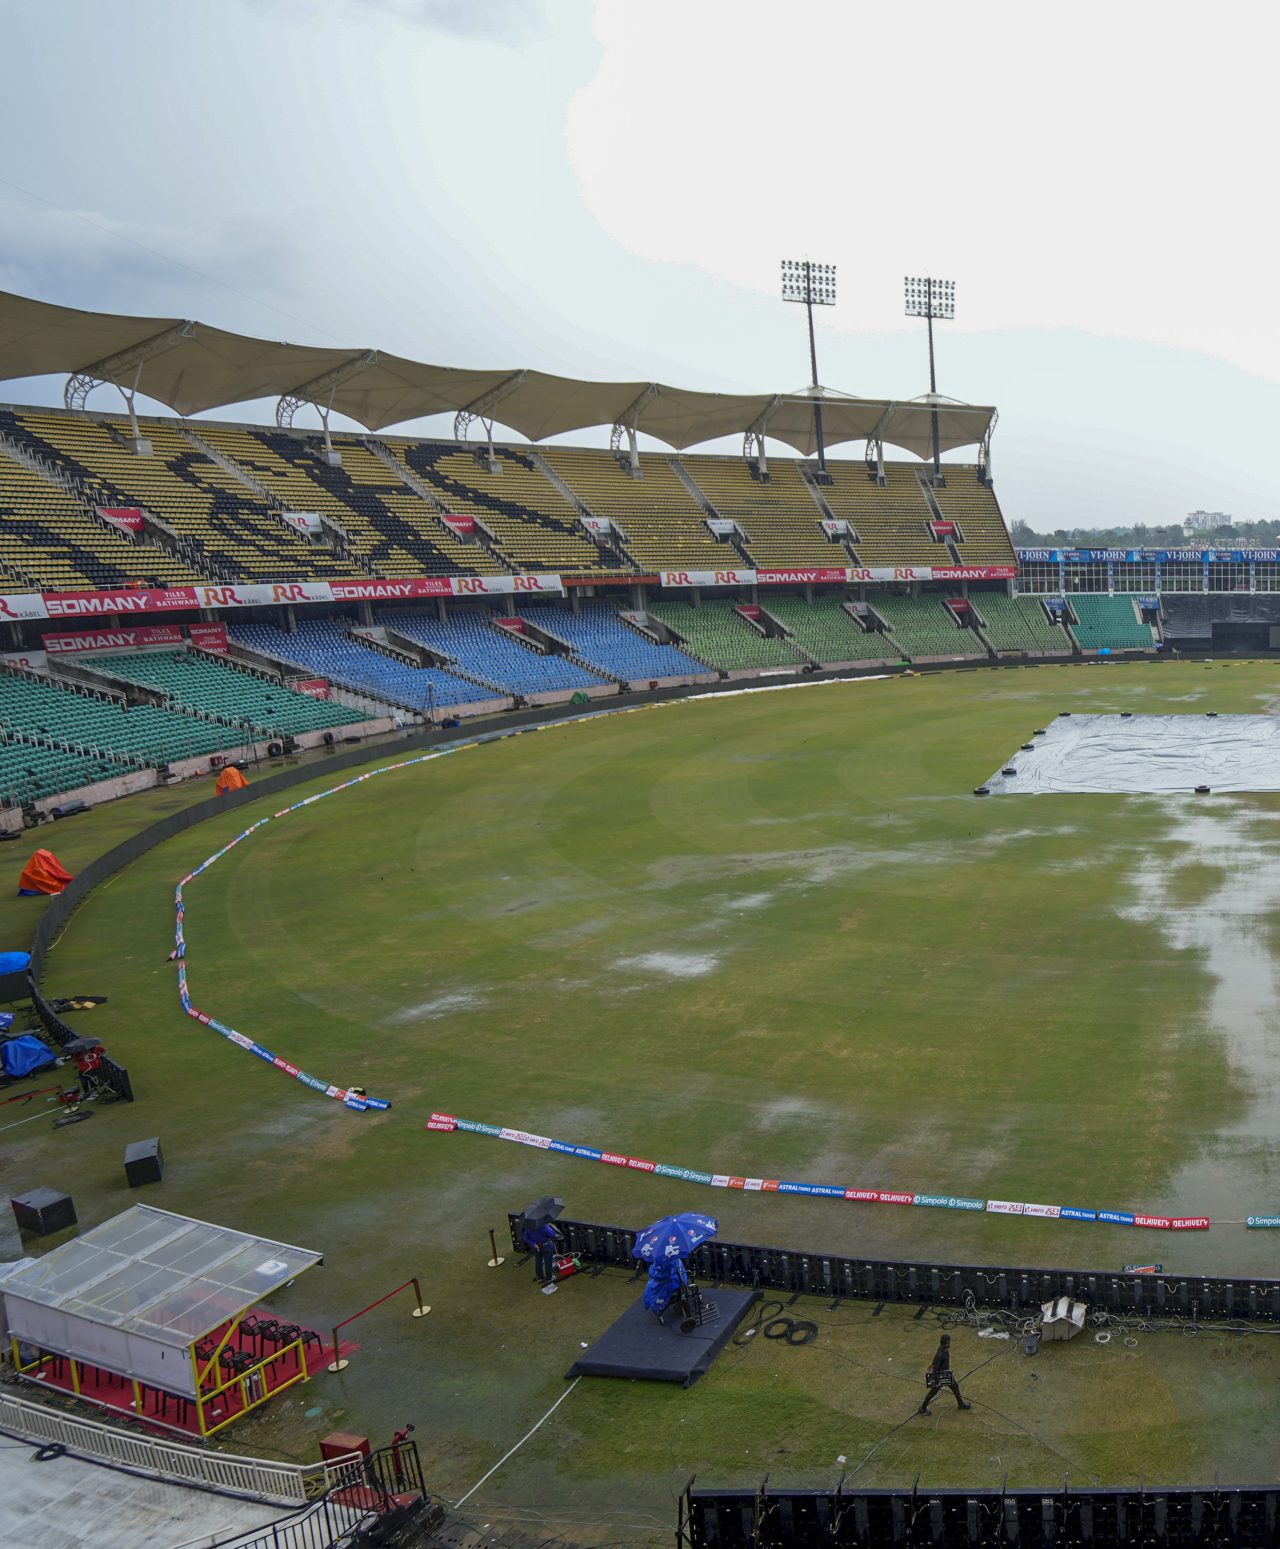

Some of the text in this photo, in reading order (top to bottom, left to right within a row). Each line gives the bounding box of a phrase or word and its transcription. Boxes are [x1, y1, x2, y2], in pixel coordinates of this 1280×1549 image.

[1015, 551, 1050, 560] VI-JOHN
[1090, 551, 1126, 560] VI-JOHN
[1166, 551, 1202, 560] VI-JOHN
[1242, 551, 1277, 560] VI-JOHN
[665, 571, 692, 585] RR
[715, 570, 740, 584] RR
[756, 572, 817, 583] SOMANY
[850, 569, 873, 580] RR
[893, 568, 917, 579] RR
[932, 570, 987, 578] SOMANY
[457, 578, 488, 593] RR
[513, 577, 543, 591] RR
[165, 590, 186, 598] TILES
[204, 588, 243, 606] RR
[272, 585, 312, 602] RR
[332, 584, 412, 600] SOMANY
[46, 597, 148, 615] SOMANY
[157, 599, 199, 607] BATHWARE
[47, 632, 137, 651] SOMANY
[427, 1121, 455, 1130] DELHIVERY
[457, 1120, 476, 1130] Simpolo
[481, 1124, 501, 1135] Simpolo
[601, 1153, 627, 1164] DELHIVERY
[628, 1159, 655, 1170] DELHIVERY
[661, 1166, 682, 1177] Simpolo
[689, 1172, 711, 1183] Simpolo
[846, 1191, 879, 1199] DELHIVERY
[880, 1194, 913, 1203] DELHIVERY
[921, 1196, 947, 1206] Simpolo
[956, 1200, 982, 1210] Simpolo
[1061, 1209, 1082, 1217] ASTRAL
[1099, 1212, 1120, 1220] ASTRAL
[1135, 1217, 1170, 1227] DELHIVERY
[1173, 1218, 1208, 1228] DELHIVERY
